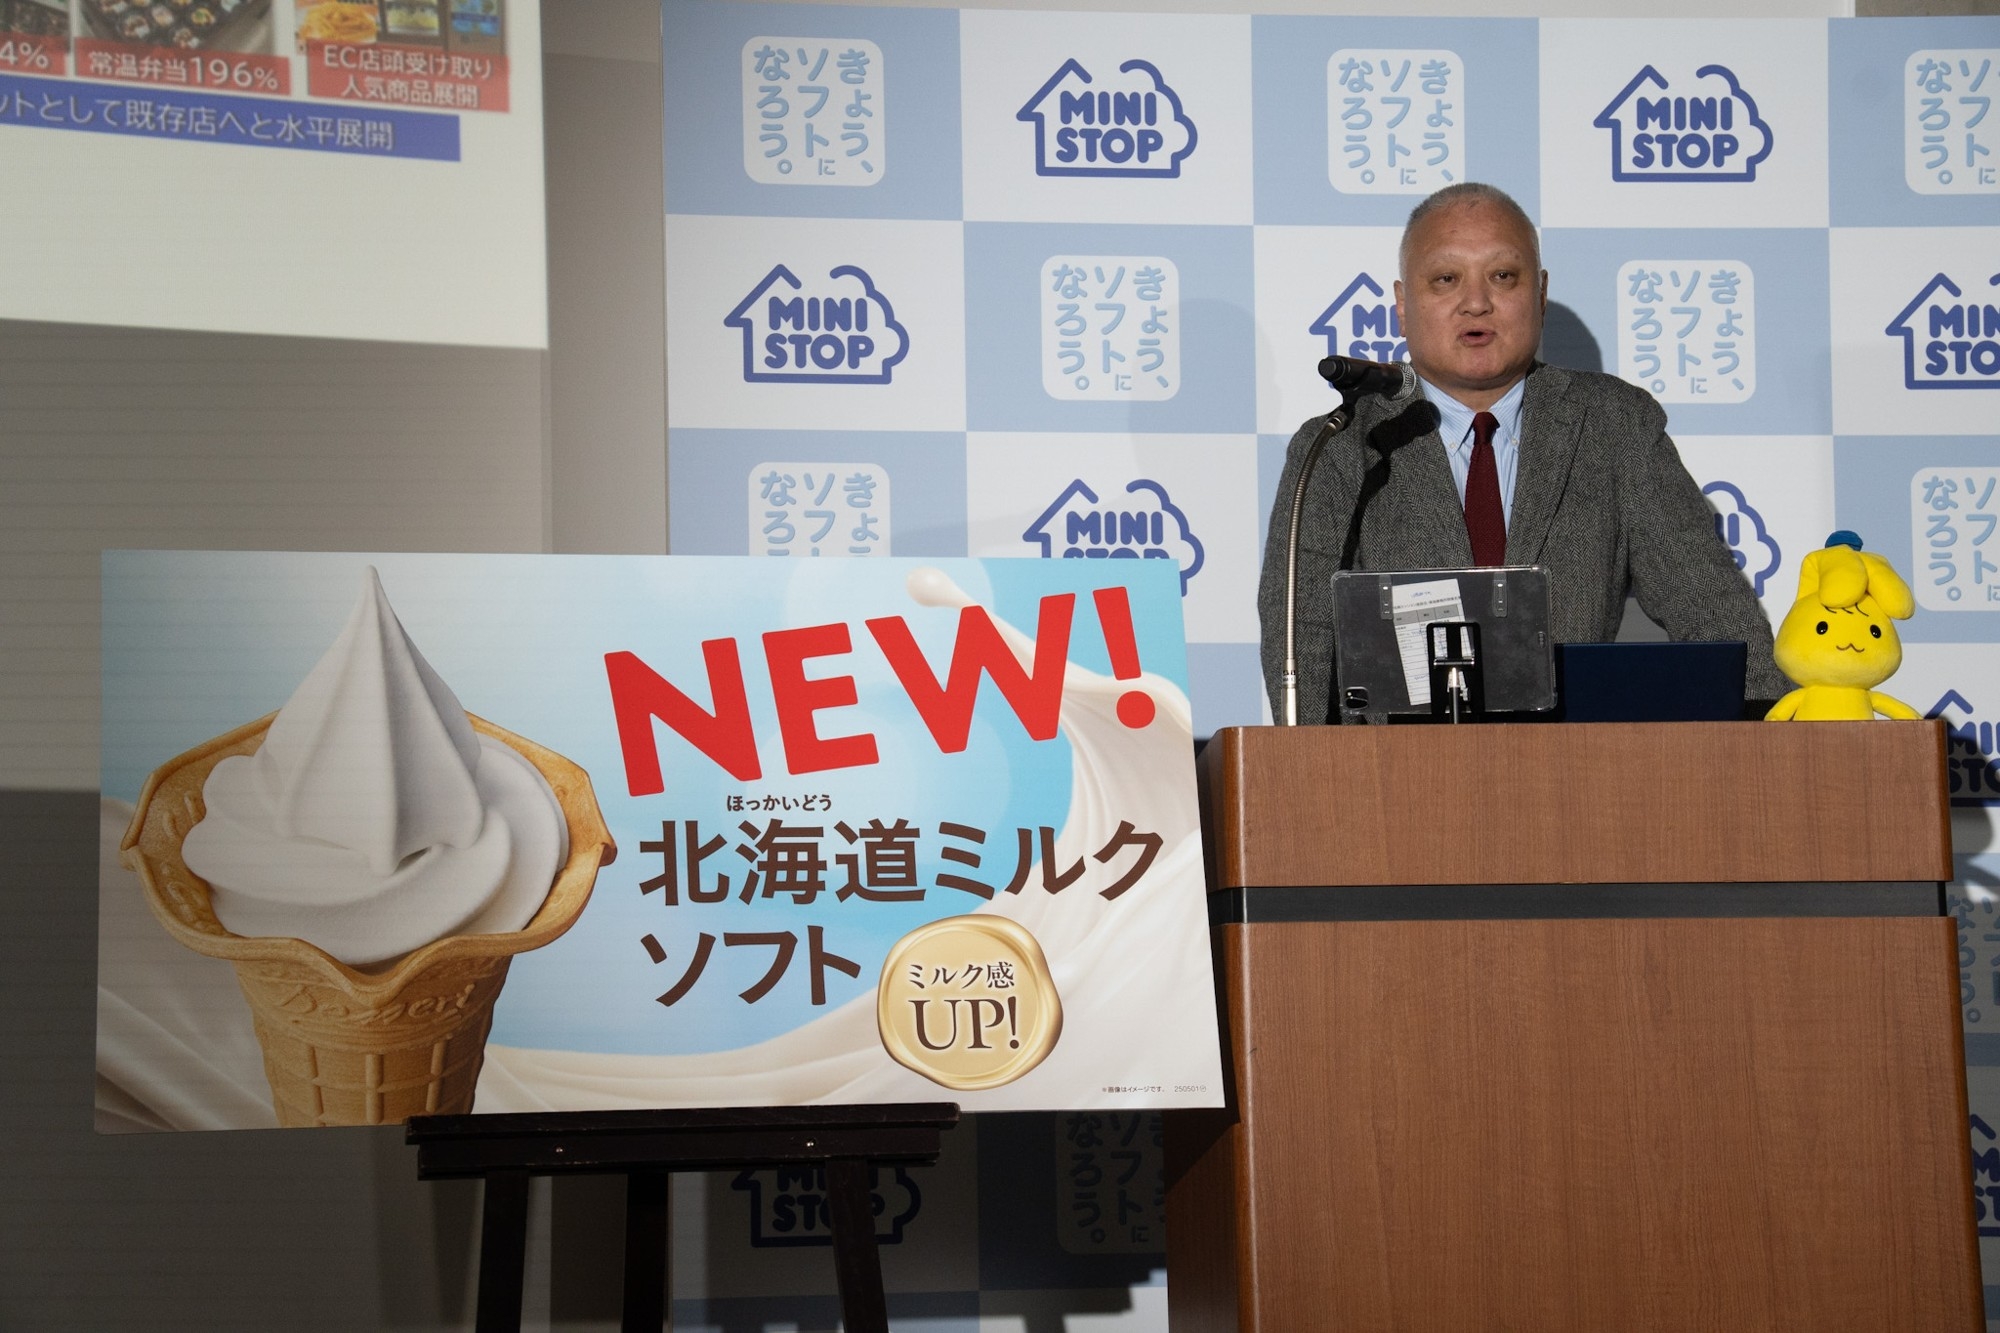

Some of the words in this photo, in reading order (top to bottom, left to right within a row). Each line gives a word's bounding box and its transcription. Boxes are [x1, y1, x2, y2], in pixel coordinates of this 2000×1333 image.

[88, 51, 279, 90] 常温弁当196%
[323, 44, 492, 79] EC店頭受け取り
[341, 75, 479, 108] 人気商品展開
[753, 45, 793, 174] なろう。
[797, 48, 836, 175] ソフトに
[836, 48, 874, 173] きょう、
[1060, 90, 1157, 126] MINI
[1338, 57, 1375, 184] なろう。
[1380, 59, 1417, 185] ソフトに
[1418, 59, 1454, 182] きょう、
[1636, 96, 1733, 131] MINI
[1916, 59, 1953, 185] なろう。
[1959, 59, 1996, 185] ソフトに
[1056, 127, 1164, 164] STOP
[1632, 133, 1739, 169] STOP
[764, 332, 875, 370] STOP
[769, 296, 868, 332] MINI
[1052, 264, 1089, 391] なろう。
[1094, 266, 1132, 391] ソフトに
[1133, 265, 1169, 388] きょう、
[1628, 268, 1666, 394] なろう。
[1670, 270, 1708, 394] ソフトに
[1708, 270, 1744, 391] きょう、
[1925, 340, 2000, 376] STO
[1066, 510, 1163, 545] MINI
[1922, 475, 1961, 601] なろう。
[1965, 477, 2000, 601] ソフトに
[604, 586, 1156, 797] NEW!
[638, 817, 1165, 906] 北海道ミルク
[726, 794, 832, 812] ほっかいどう
[640, 925, 862, 1007] ソフト
[908, 961, 1015, 989] ミルク感
[908, 996, 1020, 1051] UP!
